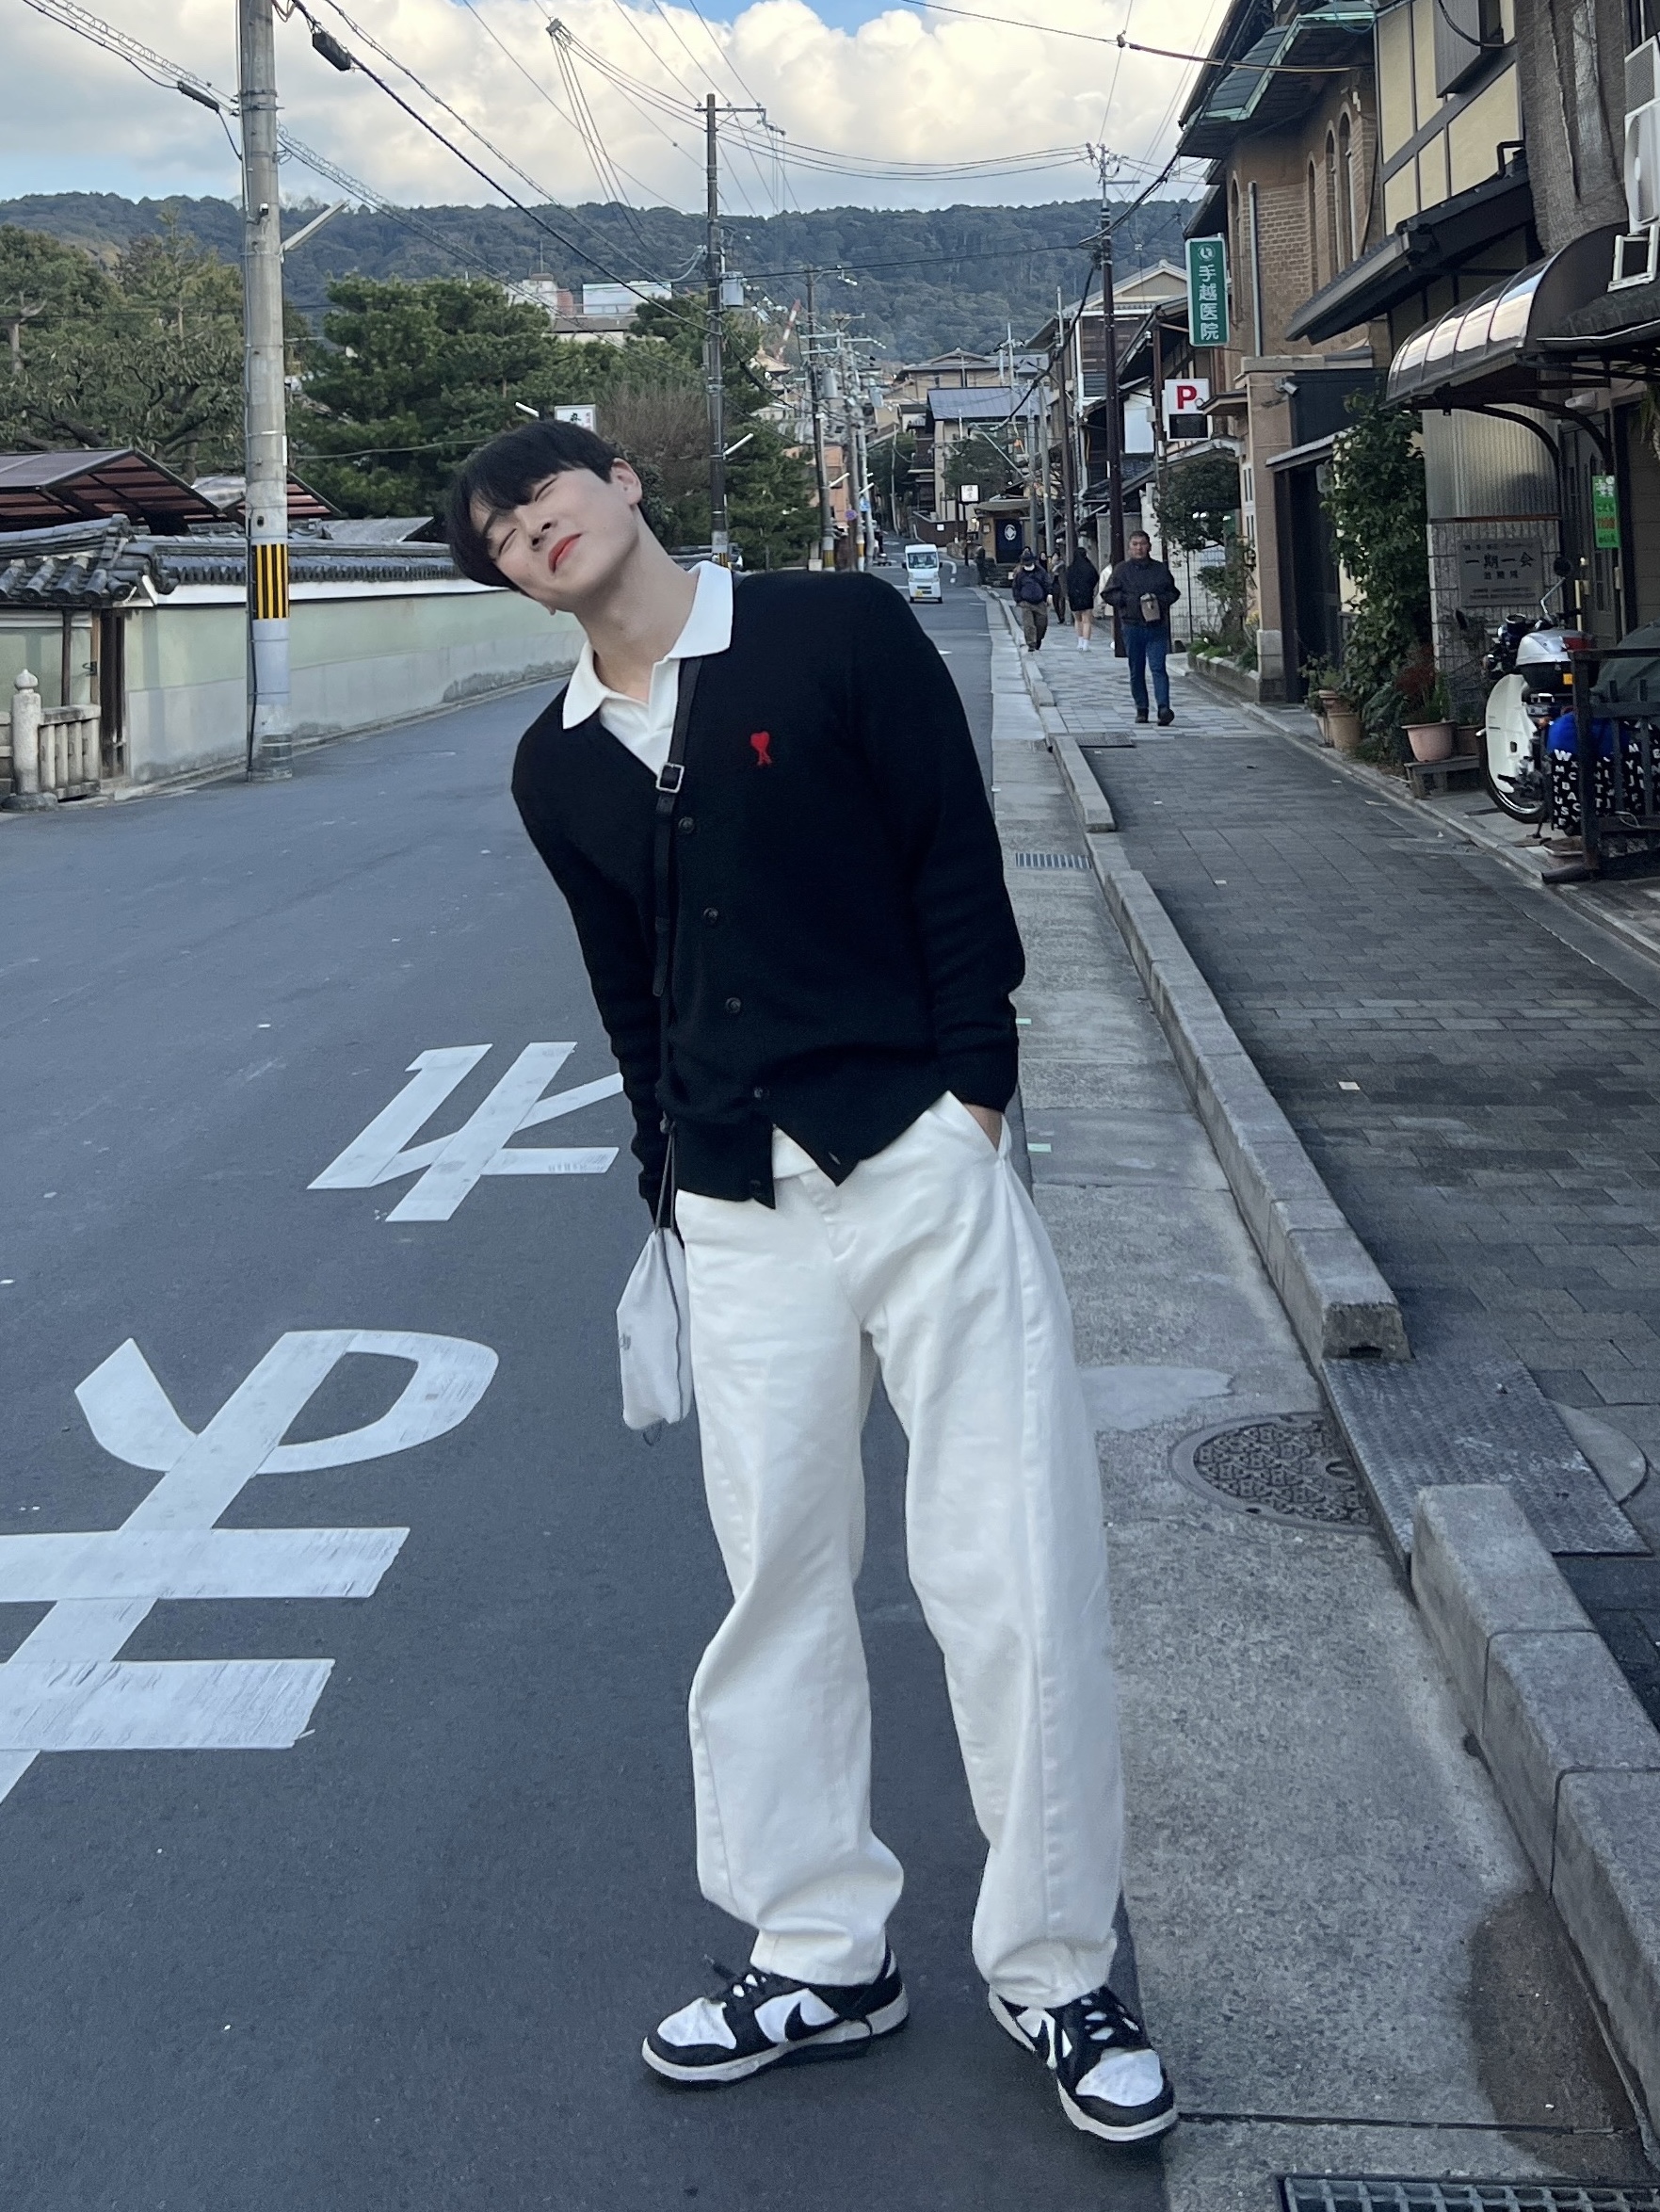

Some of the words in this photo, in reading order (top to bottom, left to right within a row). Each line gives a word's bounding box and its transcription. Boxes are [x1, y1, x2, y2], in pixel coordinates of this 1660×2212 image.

[1198, 263, 1219, 342] 手越医院
[1176, 384, 1198, 410] P
[1465, 551, 1537, 570] 一期一会
